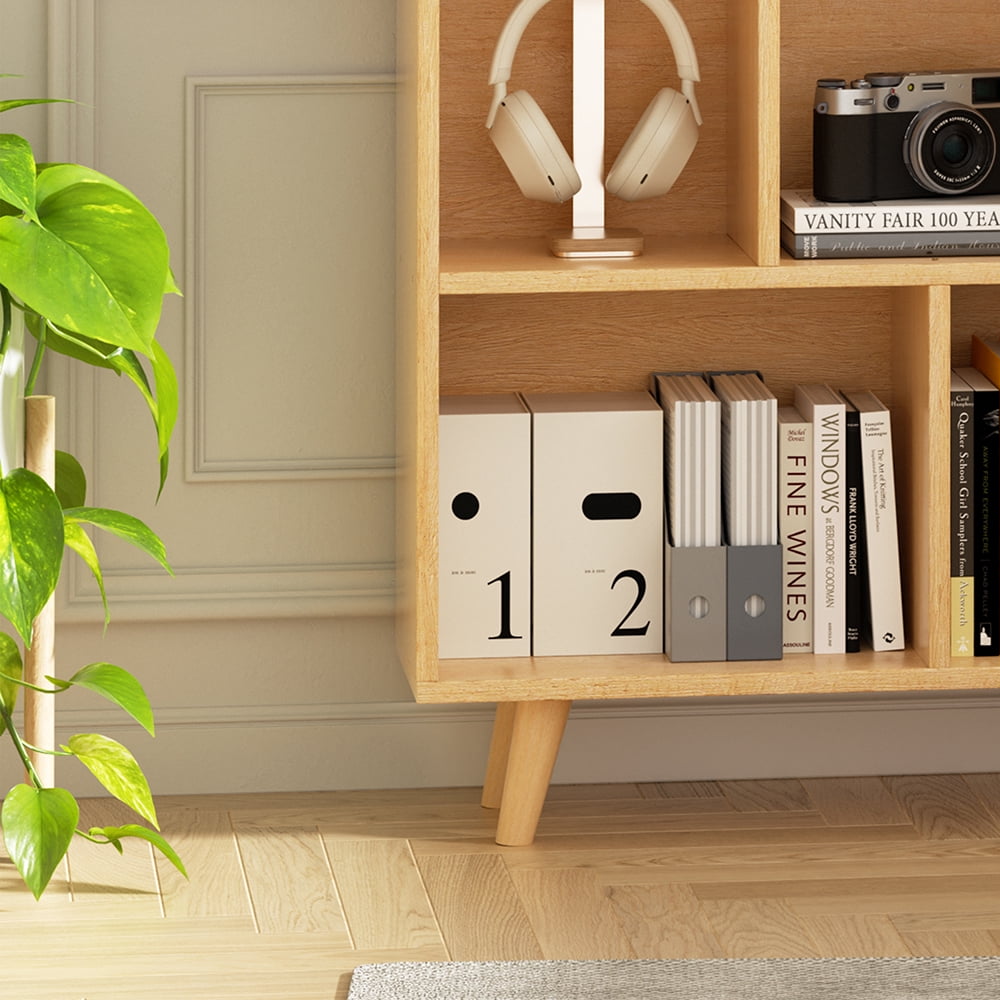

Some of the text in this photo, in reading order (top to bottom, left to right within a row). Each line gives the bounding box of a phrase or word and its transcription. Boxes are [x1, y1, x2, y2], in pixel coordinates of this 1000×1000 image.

[804, 213, 876, 229] VANITY
[883, 212, 924, 228] FAIR
[930, 212, 958, 228] 100
[878, 240, 905, 250] and
[821, 413, 839, 608] WINDOWS BERGDORF GOODMAN
[957, 412, 969, 576] Quaker School Girl Samplers from
[786, 456, 807, 621] FINE WINES
[849, 487, 857, 576] FRANK LLOYD WRIGHT
[487, 570, 522, 640] 1
[610, 569, 651, 637] 2
[959, 581, 969, 627] Ackworth
